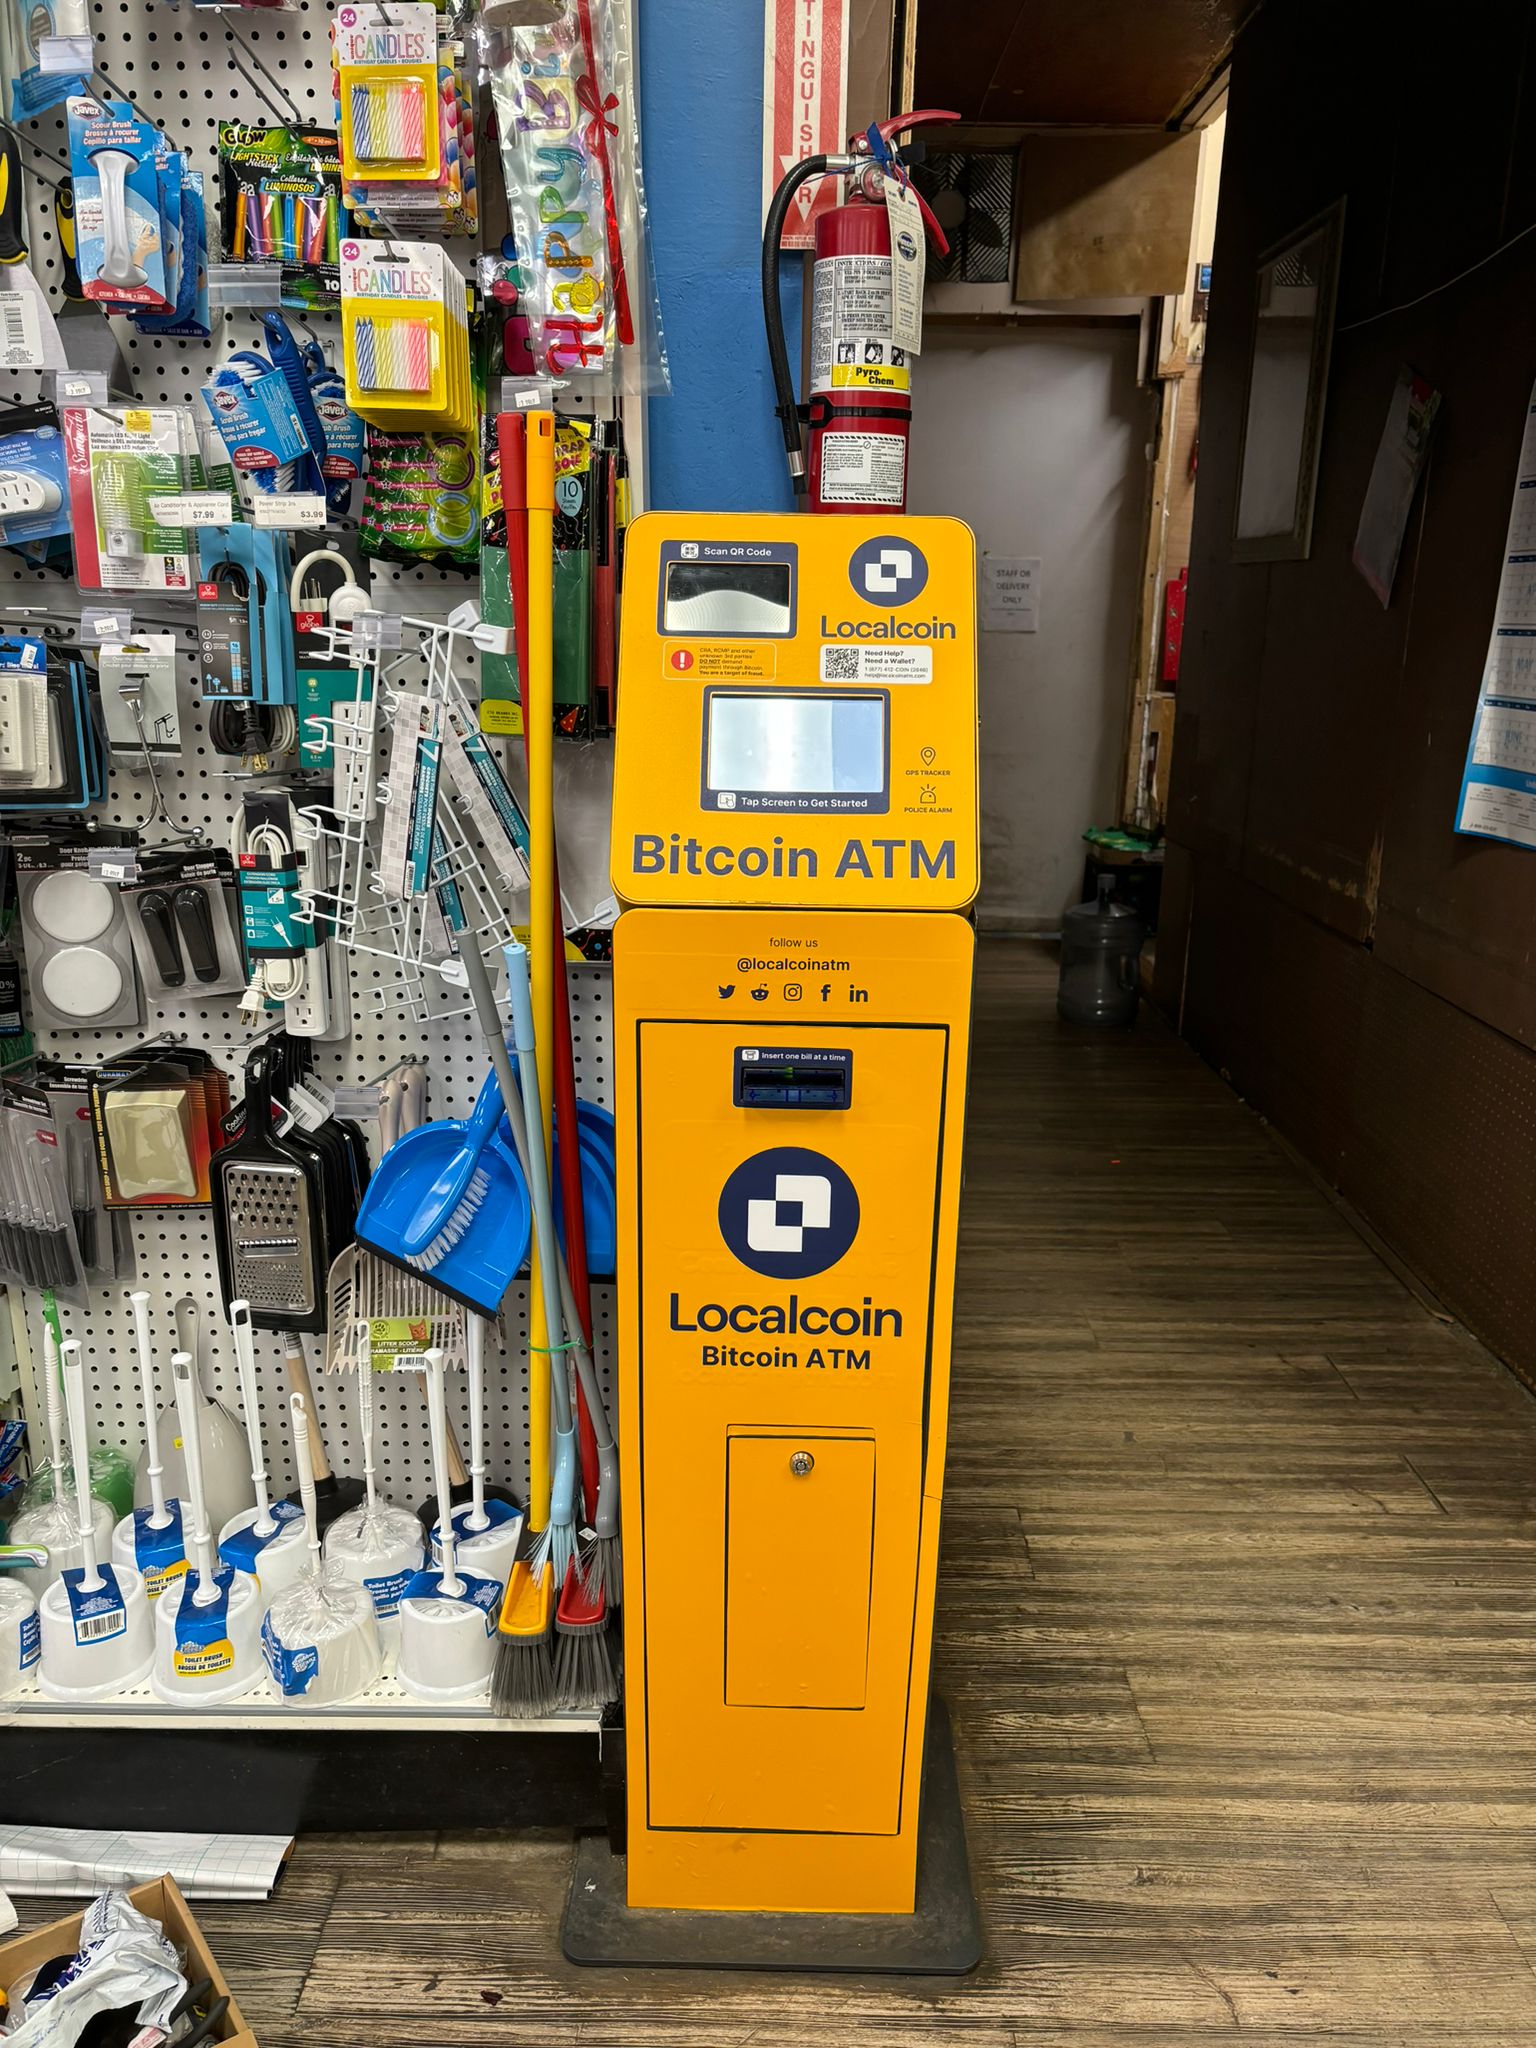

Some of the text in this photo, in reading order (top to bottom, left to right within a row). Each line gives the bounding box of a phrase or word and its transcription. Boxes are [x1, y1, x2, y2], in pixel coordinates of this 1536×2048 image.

[343, 13, 355, 22] 24
[354, 33, 425, 59] CANDLES
[798, 0, 815, 203] TINGUISHR
[74, 105, 100, 115] Javex
[223, 128, 267, 146] GLOW
[230, 152, 280, 163] LIGHTSTICK
[264, 182, 316, 192] LUMINOSOS
[345, 247, 358, 256] 24
[324, 279, 340, 291] 10
[357, 268, 432, 295] CANDLES
[856, 367, 882, 378] Pyro-
[868, 375, 894, 385] Chem
[214, 394, 238, 407] Javex
[318, 404, 347, 416] Javex
[335, 433, 357, 441] récurer
[342, 441, 360, 449] fregar
[561, 480, 579, 498] 10
[193, 501, 216, 509] Appliance
[274, 500, 287, 508] Strip
[192, 511, 215, 520] $7.99
[704, 547, 772, 556] Scan QR Code
[996, 582, 1031, 591] DELIVERY
[1002, 596, 1022, 604] ONLY
[300, 621, 320, 629] globe
[821, 615, 956, 639] Localcoin
[884, 650, 904, 658] Help?
[465, 737, 487, 752] 7
[418, 744, 438, 763] 7
[741, 797, 868, 808] Tap Screen to Get Started
[16, 852, 24, 862] 2
[632, 833, 956, 879] Bitcoin ATM
[195, 862, 215, 871] Stopper
[769, 937, 818, 948] follow us
[736, 957, 850, 973] @localcoinatm
[761, 1052, 784, 1061] Insert
[785, 1053, 800, 1061] one
[801, 1052, 813, 1061] bill
[814, 1054, 822, 1062] at
[830, 1053, 846, 1062] time
[670, 1292, 903, 1337] Localcoin
[701, 1345, 871, 1370] Bitcoin ATM
[204, 1653, 223, 1661] BRUSH
[207, 1658, 231, 1668] TOILETTE
